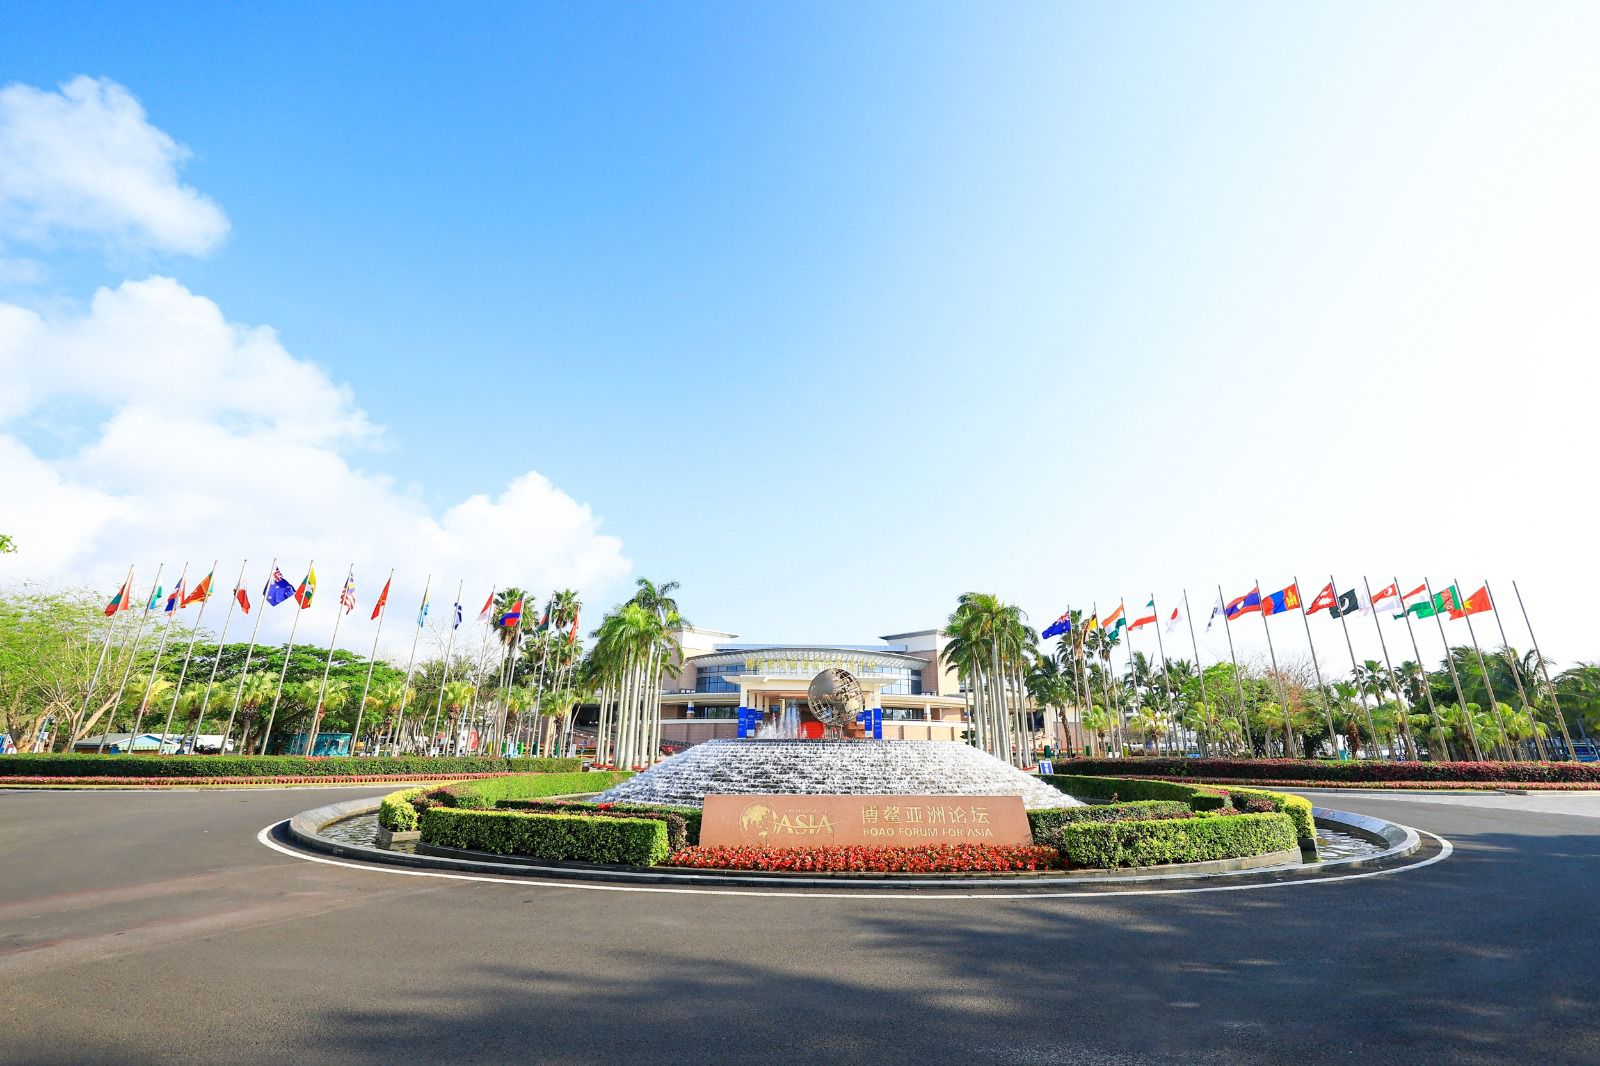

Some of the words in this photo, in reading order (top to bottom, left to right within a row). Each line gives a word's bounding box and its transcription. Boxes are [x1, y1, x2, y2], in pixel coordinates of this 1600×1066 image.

[775, 813, 834, 835] ASIA
[861, 803, 991, 825] 博鳌亚洲论坛
[898, 826, 938, 838] FORUM
[942, 826, 964, 838] FOR
[967, 826, 994, 838] ASIA
